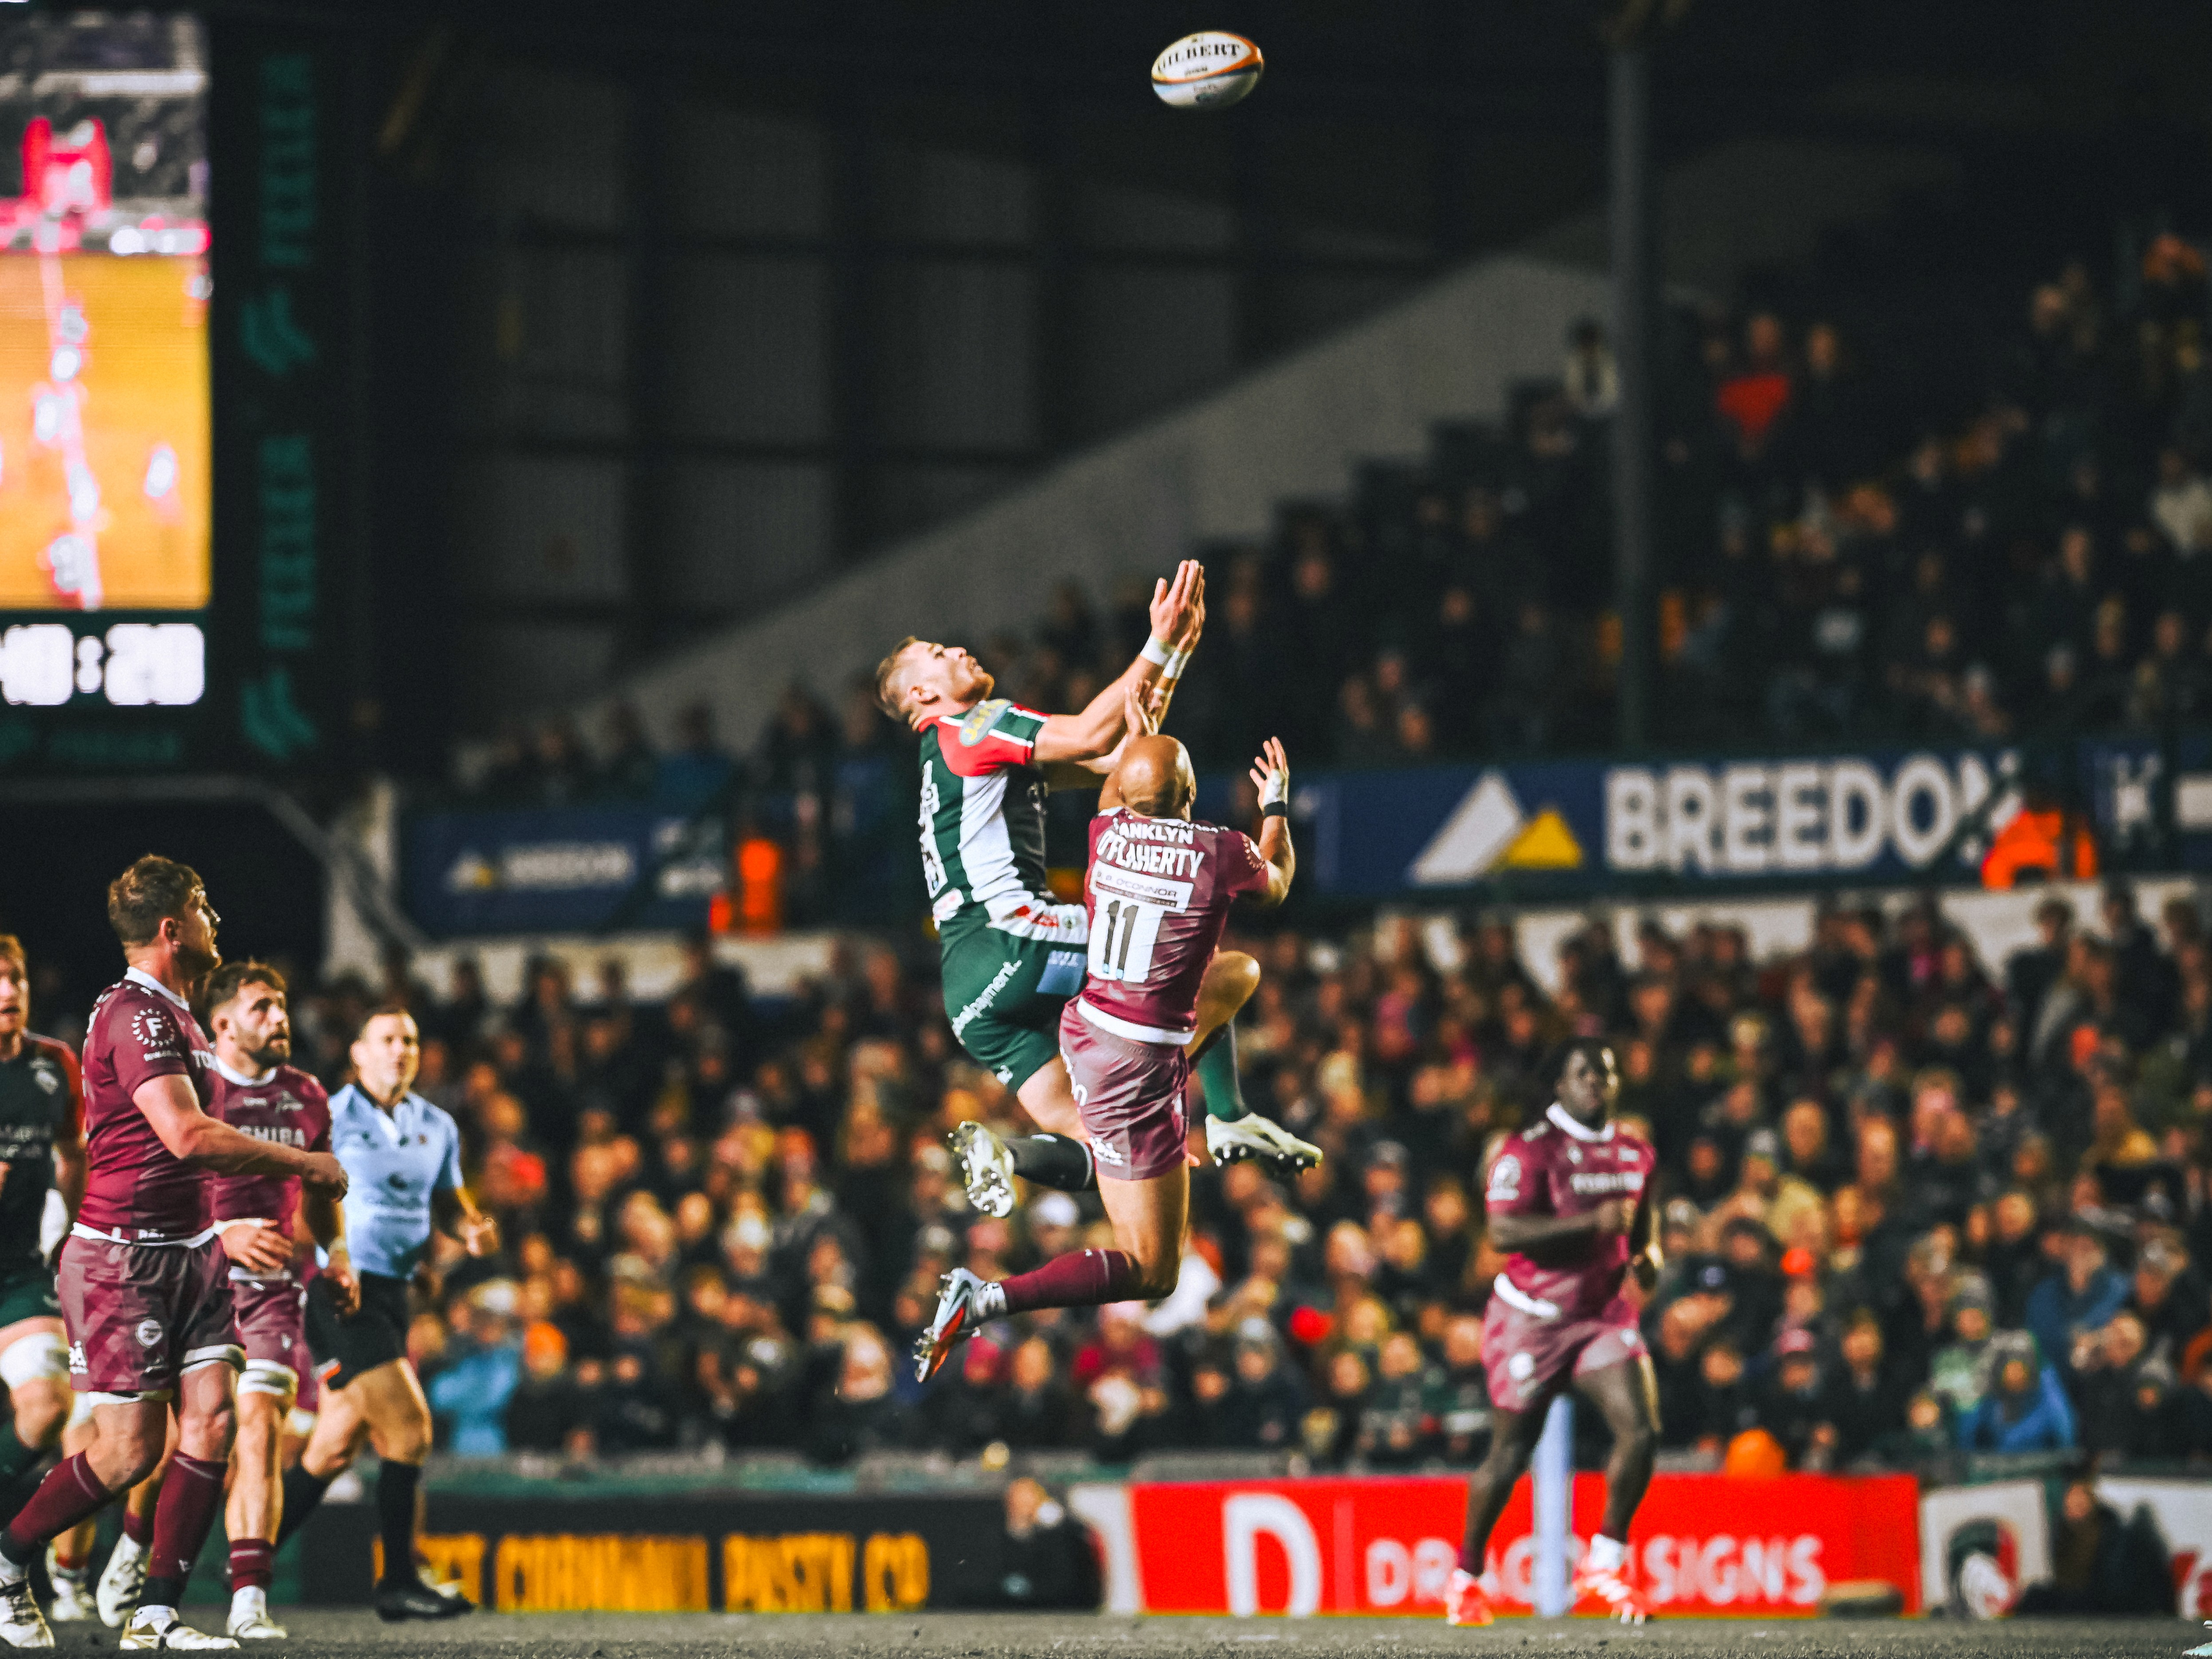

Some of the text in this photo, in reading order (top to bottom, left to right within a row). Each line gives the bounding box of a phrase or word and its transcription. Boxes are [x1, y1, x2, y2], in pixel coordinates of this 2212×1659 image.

[1112, 818, 1194, 845] ANKLYN
[1100, 899, 1141, 981] 11
[1642, 1533, 1825, 1605] SIGNS
